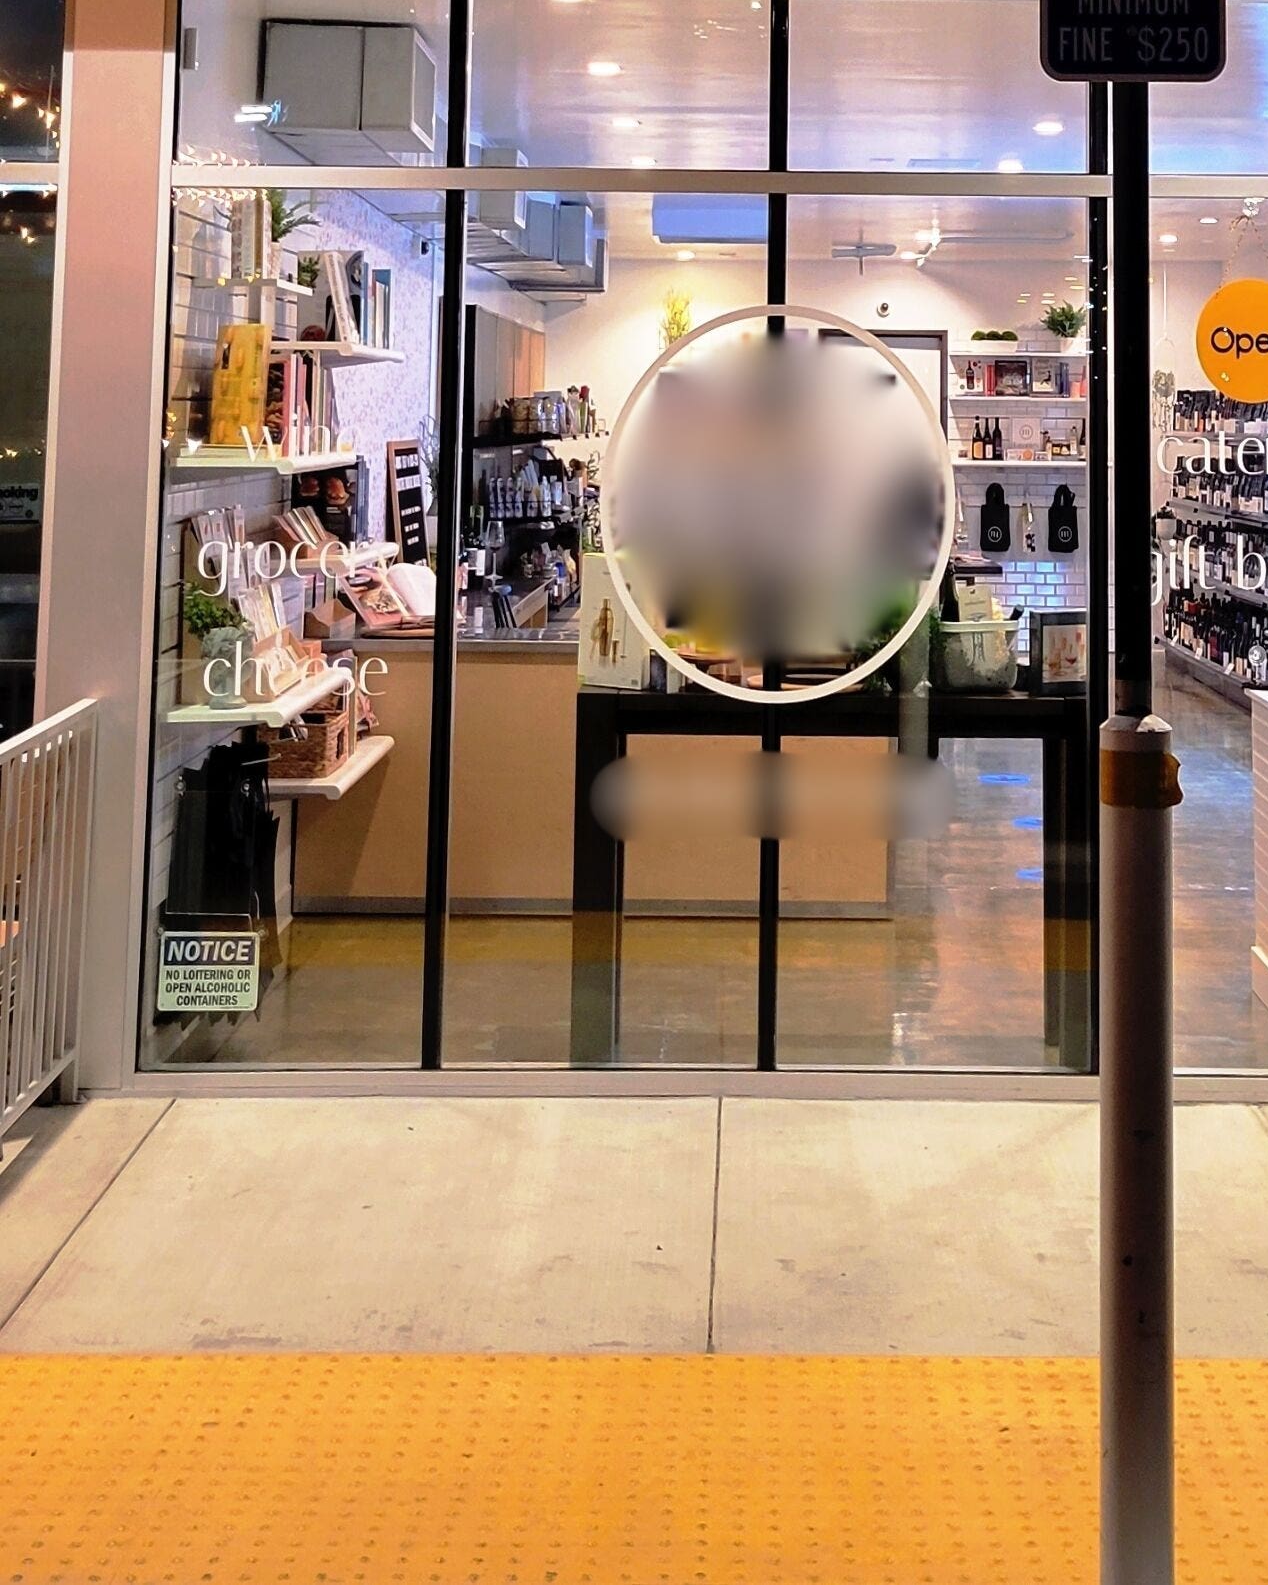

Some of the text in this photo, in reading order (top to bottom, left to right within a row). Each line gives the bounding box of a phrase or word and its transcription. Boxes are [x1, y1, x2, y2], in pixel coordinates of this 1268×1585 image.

[1059, 25, 1209, 65] FINE $250
[167, 940, 252, 962] NOTICE
[165, 969, 251, 981] NO LOITERING OR
[165, 982, 251, 993] OPEN ALCOHOLIC
[176, 995, 238, 1006] CONTAINERS
